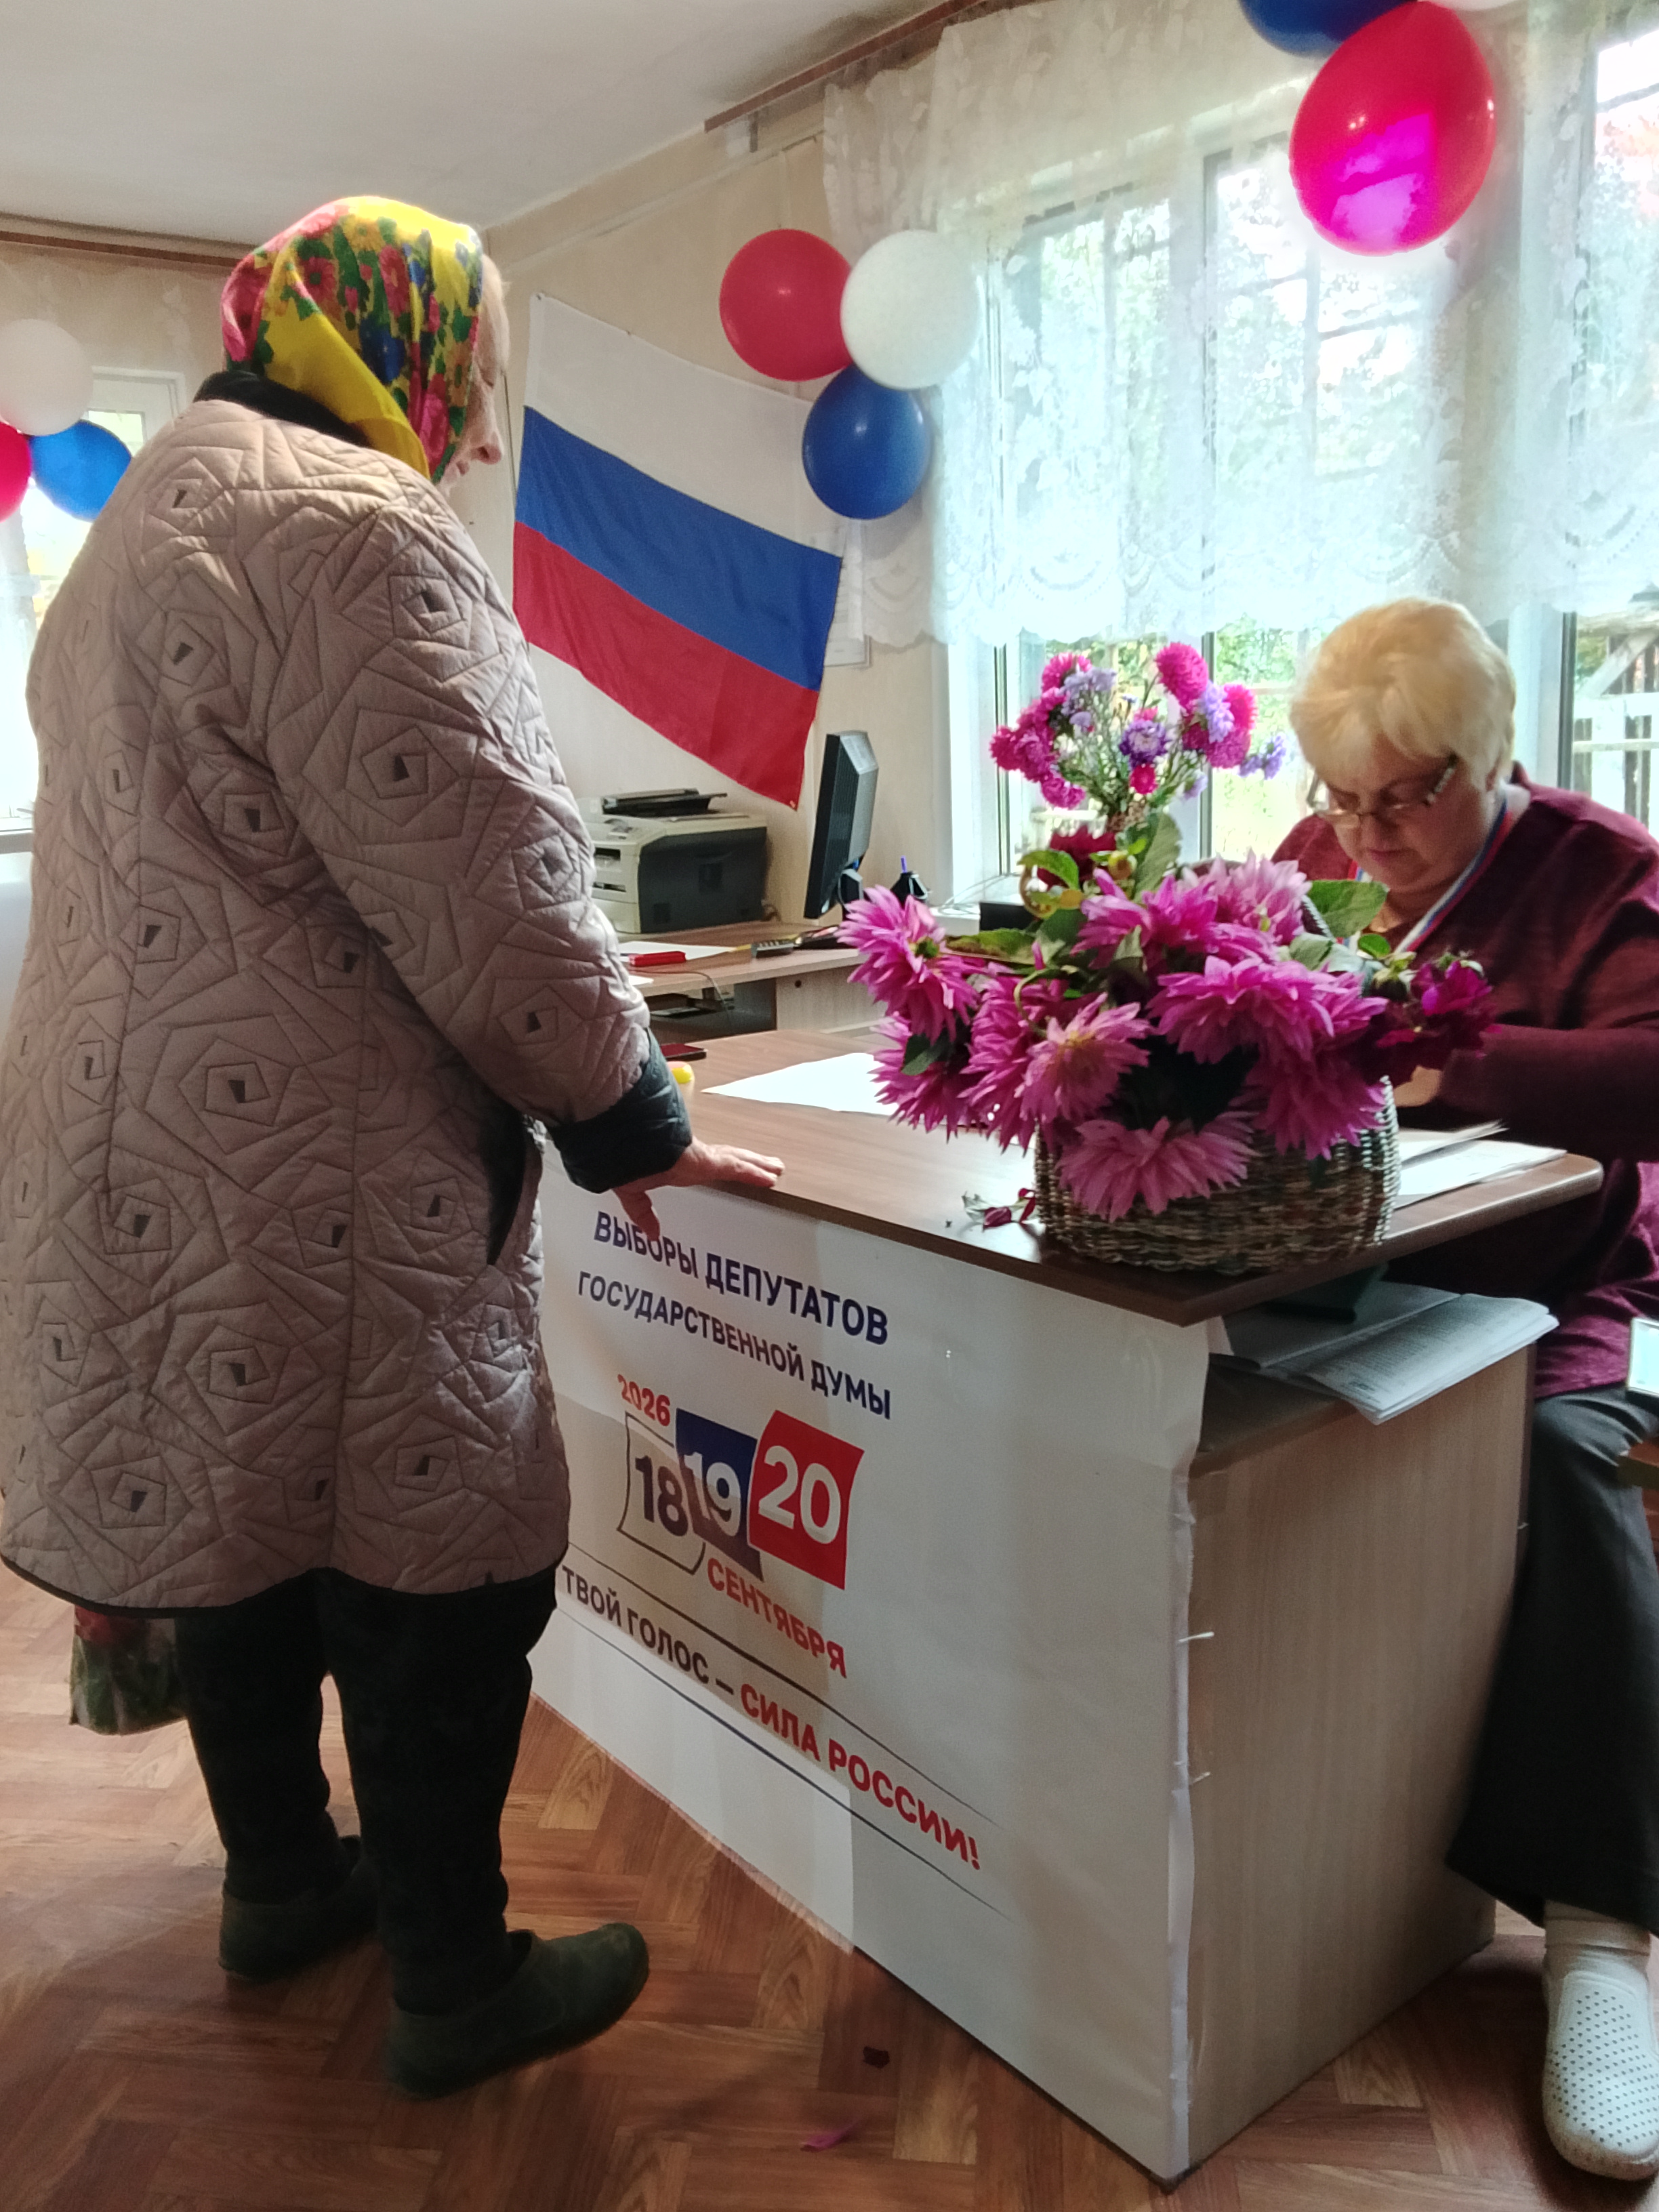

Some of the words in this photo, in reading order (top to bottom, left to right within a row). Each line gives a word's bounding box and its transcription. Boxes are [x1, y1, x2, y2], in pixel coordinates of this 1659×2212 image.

[594, 1211, 697, 1279] ВЫБОРЫ
[705, 1253, 888, 1345] ДЕПУТАТОВ
[578, 1271, 804, 1381] ГОСУДАРСТВЕННОЙ
[811, 1359, 890, 1420] ДУМЫ
[617, 1374, 671, 1427] 2026
[635, 1455, 689, 1537] 18
[683, 1452, 742, 1538] 19
[758, 1445, 842, 1544] 20
[707, 1558, 847, 1679] СЕНТЯБРЯ
[562, 1565, 621, 1627] ТВОЙ
[628, 1608, 709, 1684] ГОЛОС
[740, 1683, 821, 1762] СИЛА
[828, 1739, 981, 1870] РОССИИ!
